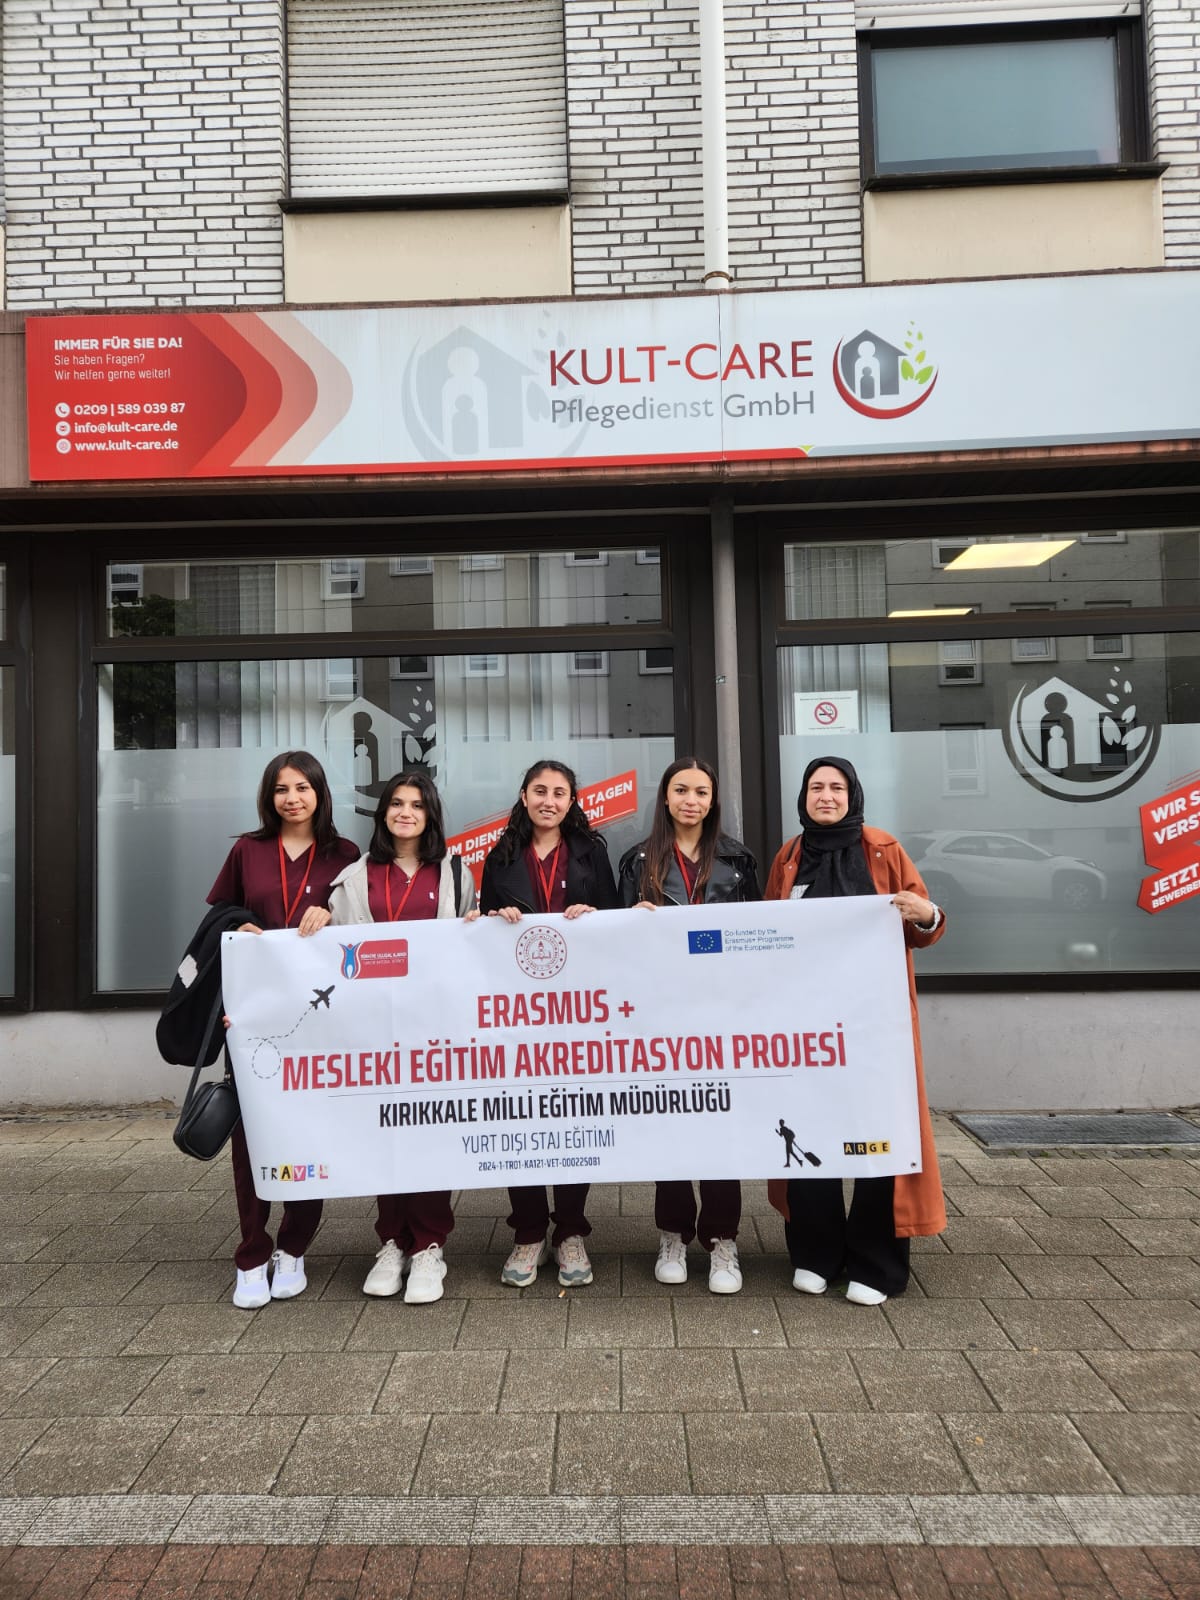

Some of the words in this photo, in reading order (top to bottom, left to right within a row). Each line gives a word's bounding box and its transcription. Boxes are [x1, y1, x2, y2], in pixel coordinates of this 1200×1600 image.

[54, 339, 99, 350] IMMER
[103, 336, 130, 350] FÜR
[133, 338, 155, 349] SIE
[158, 337, 183, 349] DA!
[54, 355, 70, 366] Sie
[73, 354, 103, 365] haben
[106, 353, 145, 367] Fragen?
[550, 340, 814, 386] KULT-CARE
[54, 370, 71, 381] Wir
[73, 369, 104, 380] helfen
[108, 371, 135, 382] gerne
[138, 367, 171, 379] weiter!
[74, 403, 108, 415] 0209
[117, 403, 141, 415] 589
[143, 403, 168, 415] 039
[170, 402, 186, 414] 87
[551, 397, 713, 429] Pflegedienst
[724, 390, 815, 418] GmbH
[74, 421, 178, 434] info@kult-care.de
[74, 438, 179, 452] www.kult-care.de
[587, 780, 633, 806] TAGEN
[1150, 797, 1186, 823] WIR
[465, 827, 507, 851] DIENS
[1153, 812, 1200, 845] VERS
[1151, 862, 1200, 897] JETZT
[1151, 879, 1200, 909] BEWERBE
[477, 989, 610, 1029] ERASMUS
[282, 1041, 401, 1092] MESLEKİ
[410, 1037, 506, 1084] EĞİTİM
[514, 1030, 724, 1079] AKREDİTASYON
[732, 1022, 847, 1070] PROJESİ
[379, 1098, 478, 1128] KIRIKKALE
[483, 1089, 533, 1121] MİLLİ
[539, 1087, 604, 1119] EĞİTİM
[610, 1082, 732, 1116] MÜDÜRLÜĞÜ
[462, 1134, 497, 1154] YURT
[501, 1132, 527, 1156] DIŞI
[530, 1131, 560, 1151] STAJ
[565, 1125, 615, 1150] EĞİTİMİ
[844, 1142, 889, 1154] ARGE
[260, 1164, 329, 1181] TRAVEL
